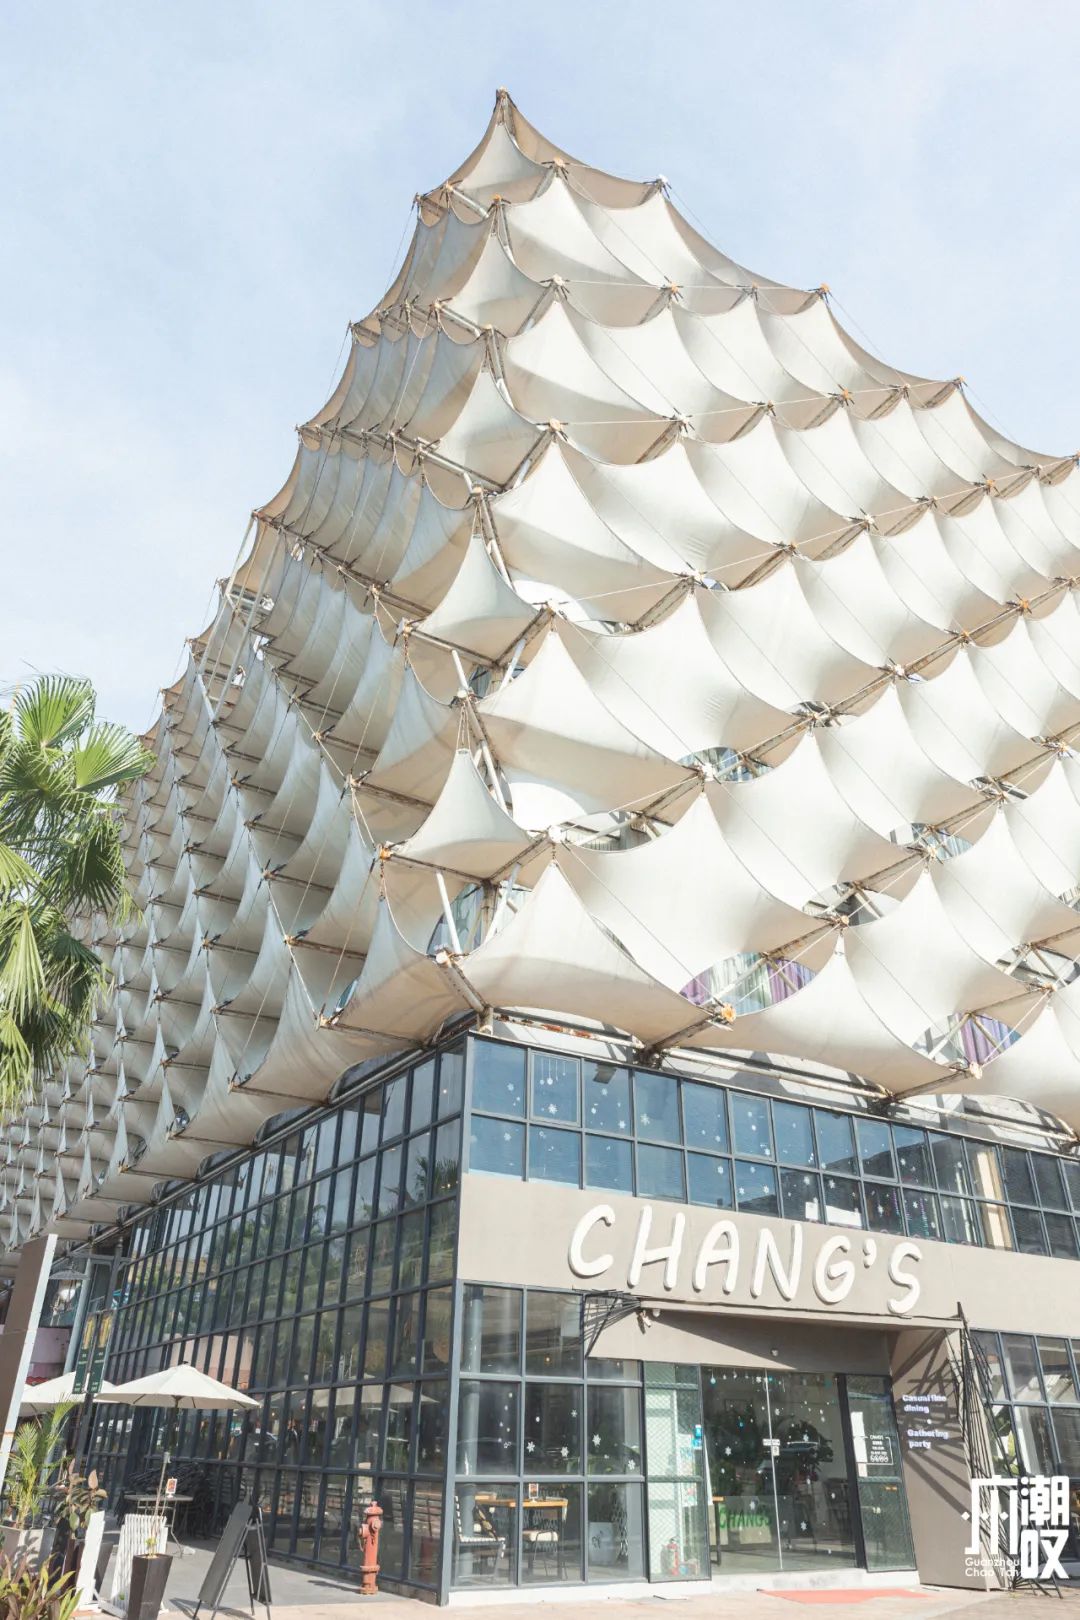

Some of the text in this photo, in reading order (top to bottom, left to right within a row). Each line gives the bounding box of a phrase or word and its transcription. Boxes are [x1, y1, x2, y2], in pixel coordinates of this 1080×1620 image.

[569, 1204, 922, 1315] CHANG'S
[902, 1394, 931, 1402] Casual
[903, 1404, 930, 1414] dining
[907, 1429, 949, 1440] Gathering
[908, 1440, 931, 1449] party
